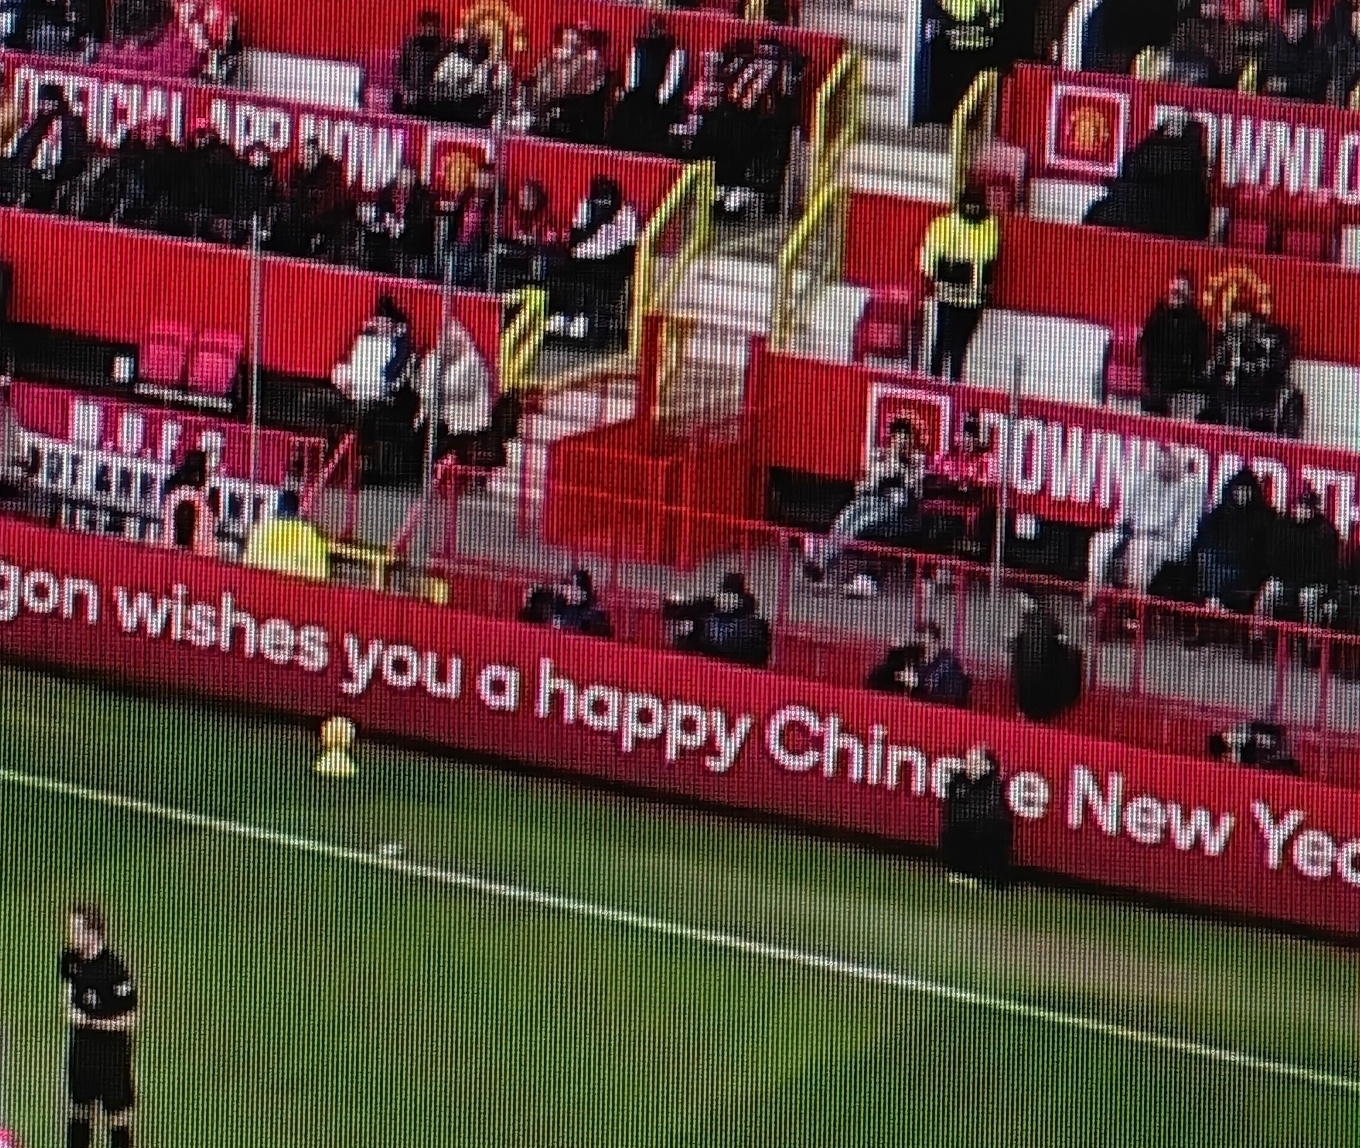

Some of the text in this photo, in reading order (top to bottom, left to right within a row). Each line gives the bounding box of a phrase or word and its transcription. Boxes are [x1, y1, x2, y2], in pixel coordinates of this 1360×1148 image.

[299, 114, 403, 192] NOW
[1152, 104, 1360, 203] OWNLO
[978, 412, 1288, 526] DOWNAD
[114, 582, 328, 670] wishes
[342, 632, 463, 699] you
[478, 668, 520, 711] a
[536, 658, 752, 772] happy
[766, 706, 1050, 821] Chinee
[1067, 764, 1236, 857] New
